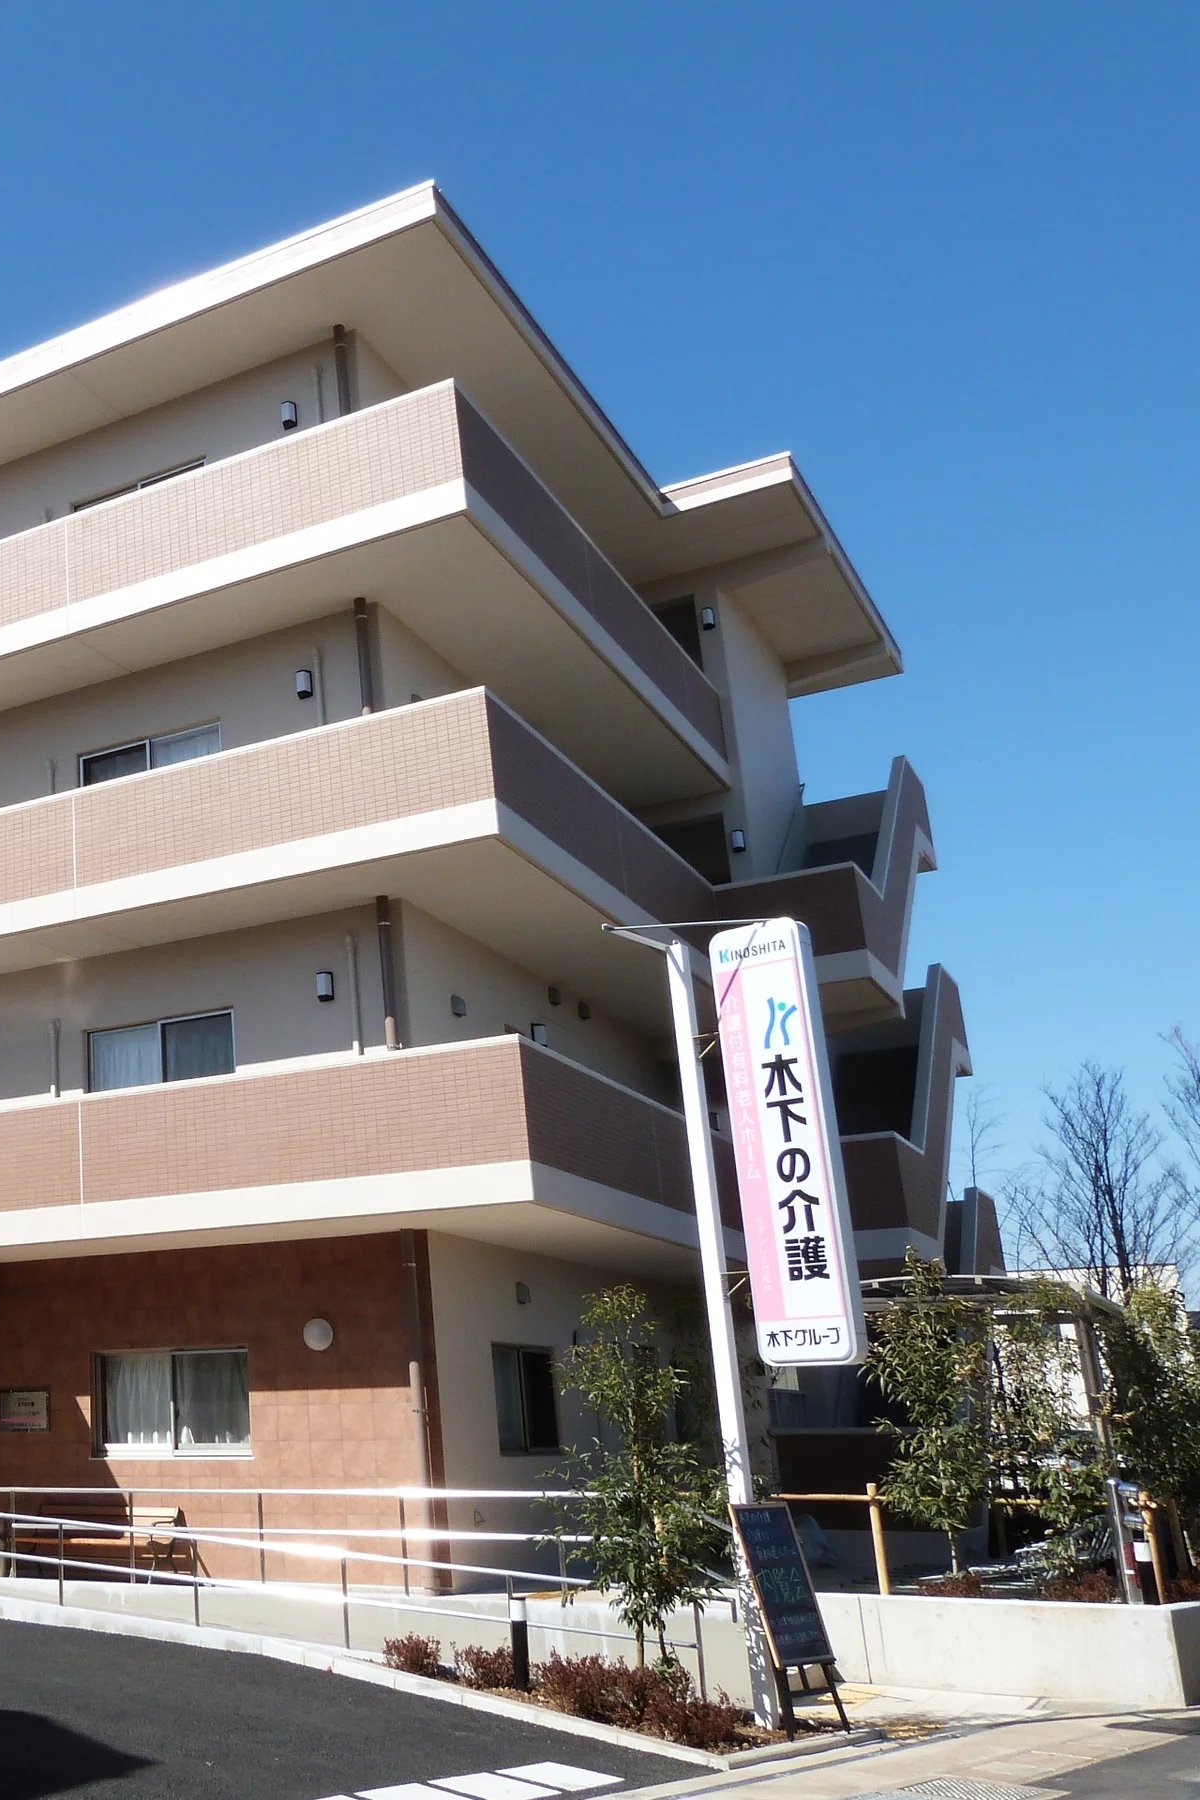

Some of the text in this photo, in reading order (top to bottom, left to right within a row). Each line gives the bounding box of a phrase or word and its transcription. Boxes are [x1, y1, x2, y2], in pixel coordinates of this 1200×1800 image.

[719, 939, 786, 964] KINOSHITA
[761, 1053, 830, 1281] 木下の介護
[766, 1327, 841, 1348] 木下グループ
